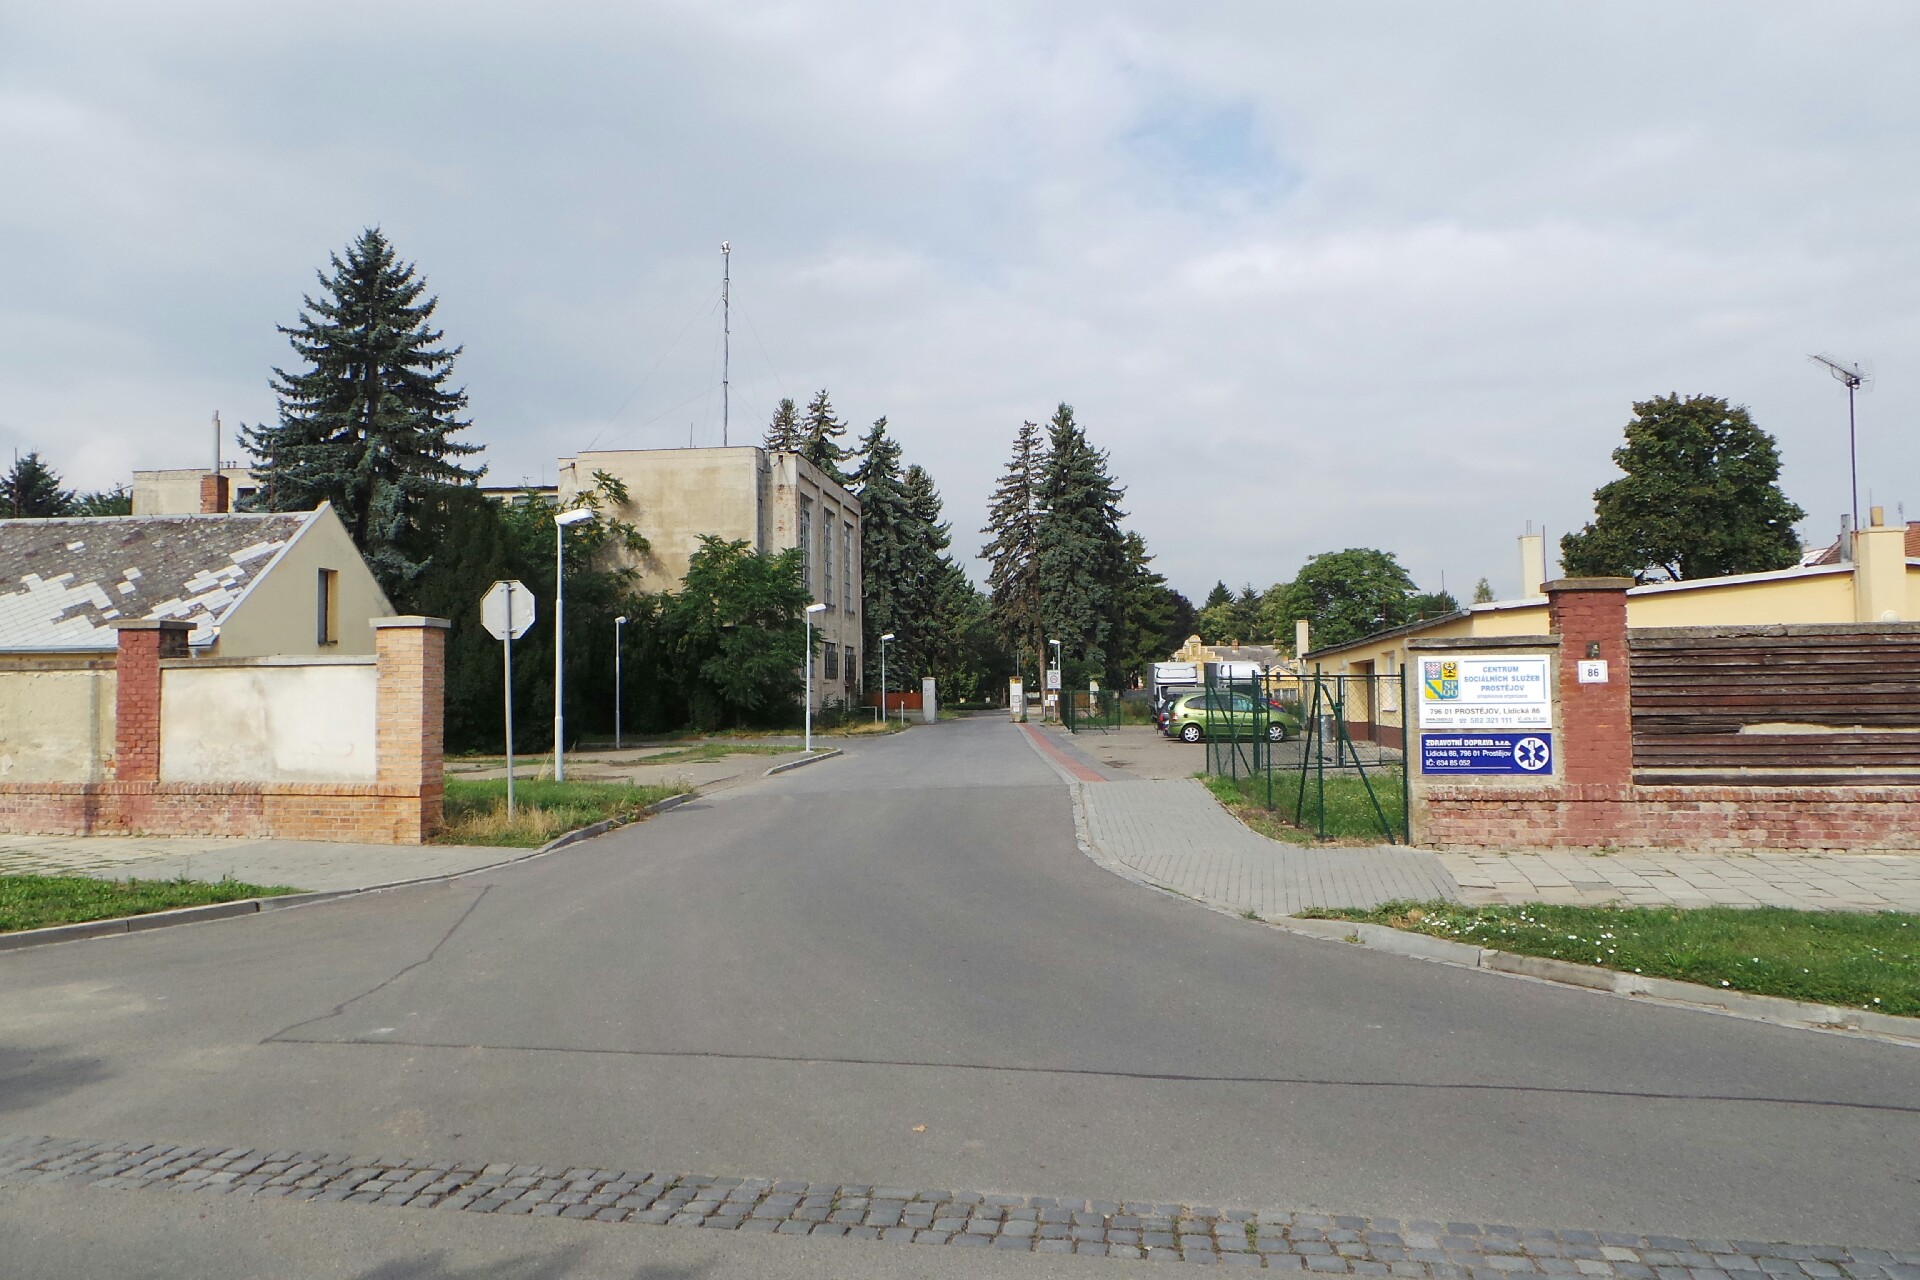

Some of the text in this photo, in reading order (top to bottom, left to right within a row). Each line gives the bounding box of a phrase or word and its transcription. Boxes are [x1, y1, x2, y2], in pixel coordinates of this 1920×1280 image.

[1587, 668, 1599, 677] 86
[1464, 674, 1541, 683] SOCIÁLNÍCH SLUŽEB
[1503, 707, 1530, 715] Lidická
[1482, 749, 1512, 758] Prostějov
